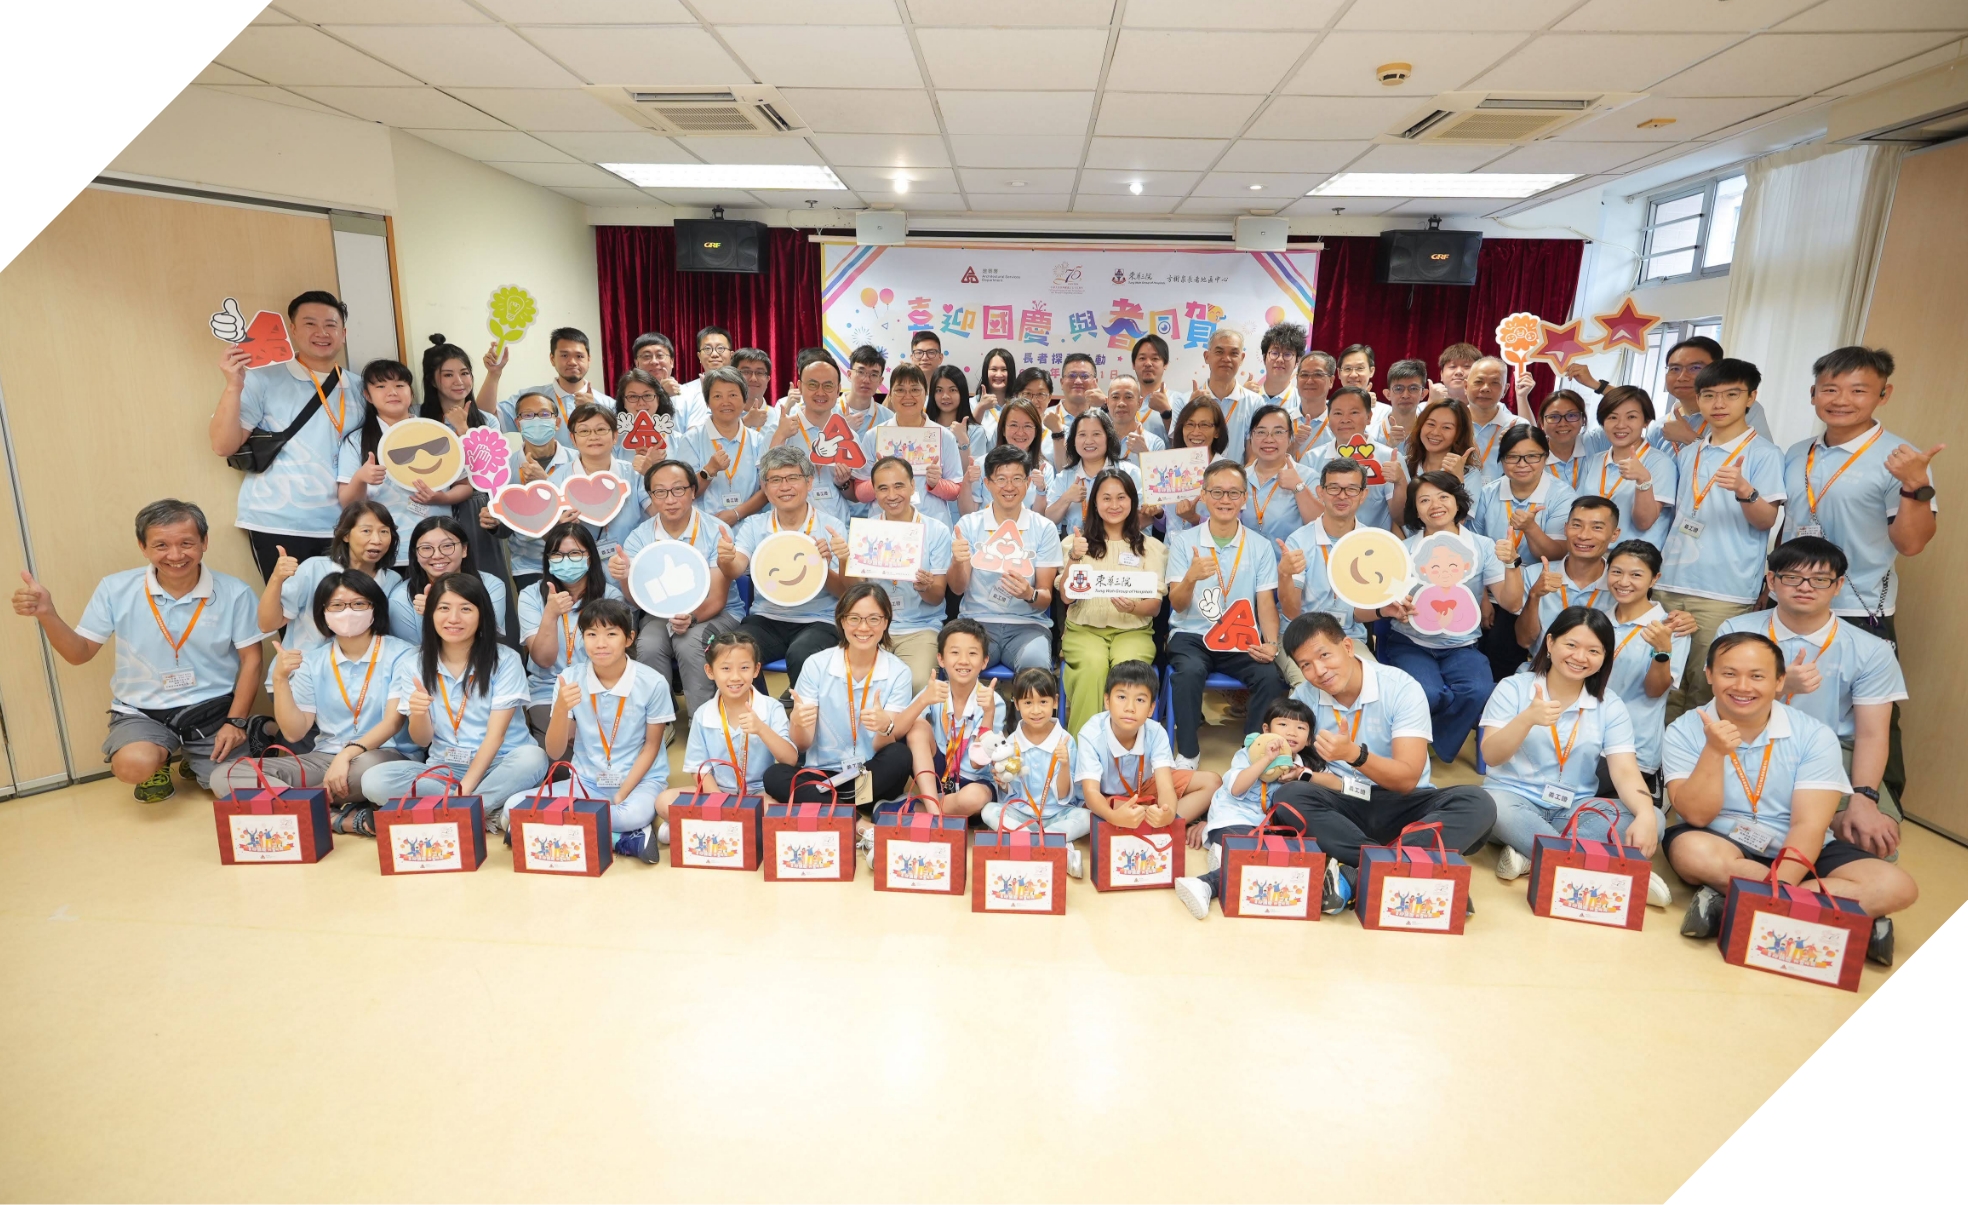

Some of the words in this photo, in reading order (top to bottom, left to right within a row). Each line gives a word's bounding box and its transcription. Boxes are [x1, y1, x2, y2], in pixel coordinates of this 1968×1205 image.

[1023, 352, 1107, 366] 長者探動
[1095, 574, 1132, 588] 東華三院
